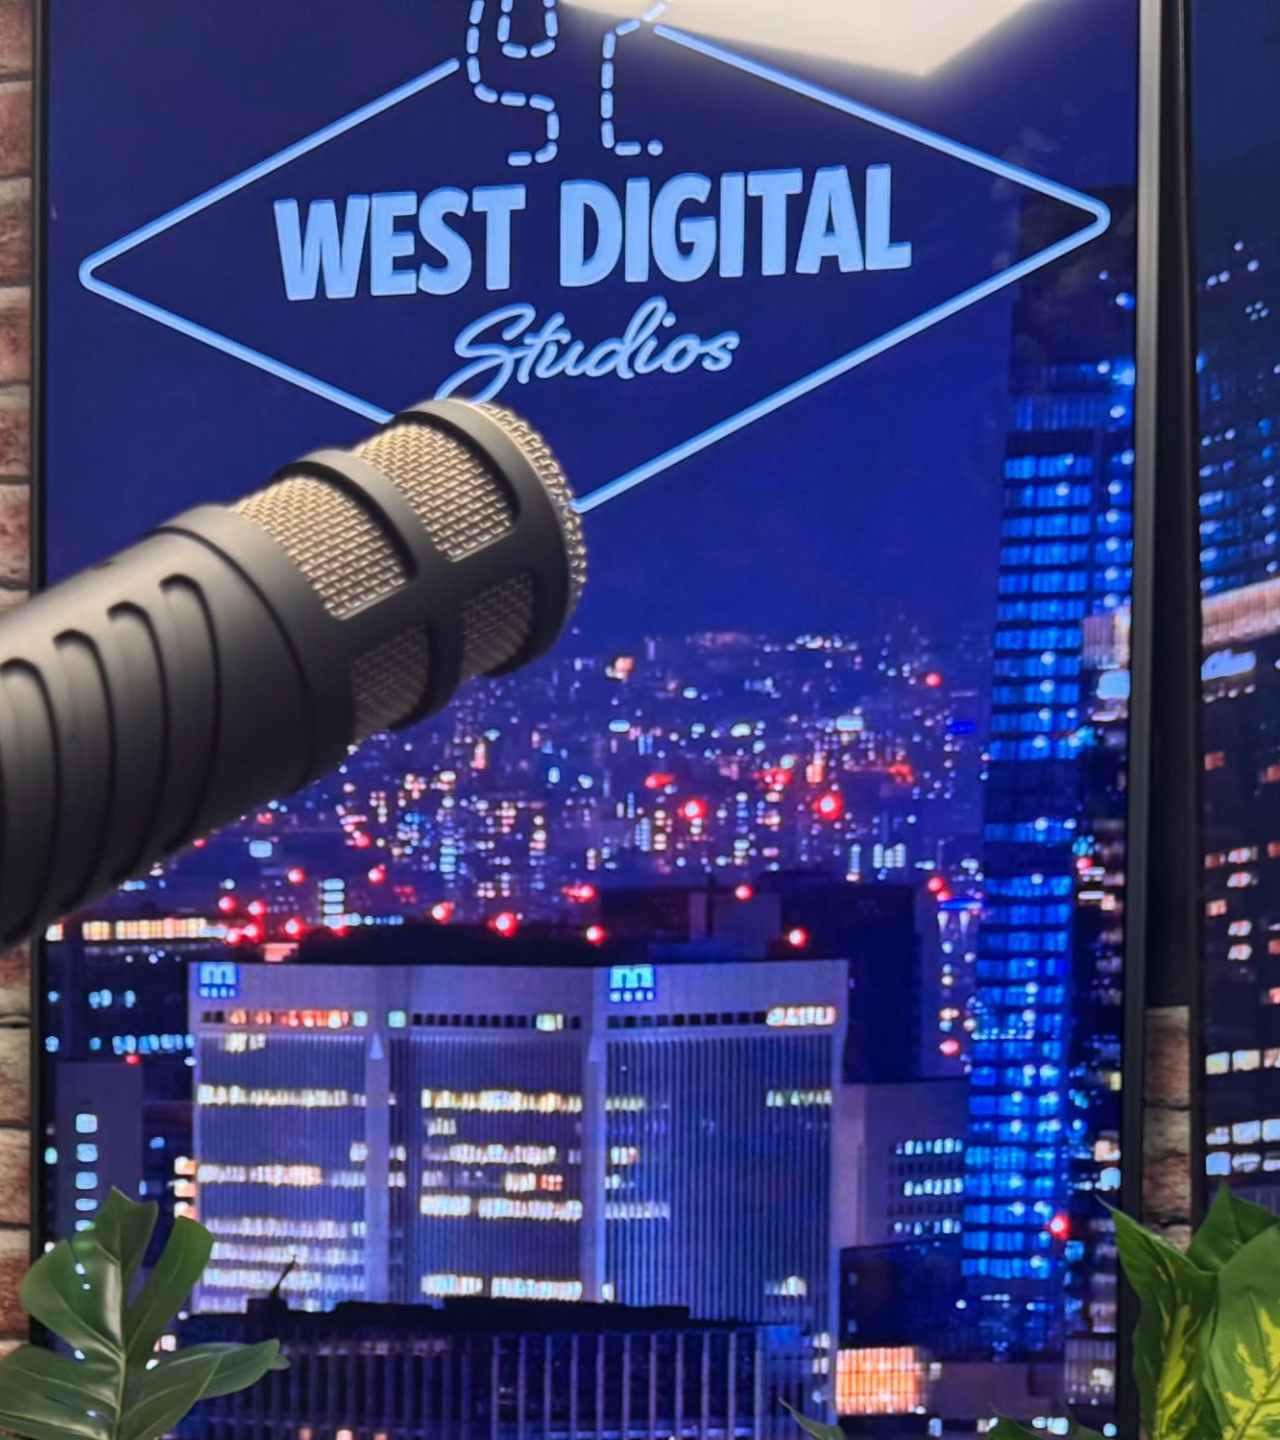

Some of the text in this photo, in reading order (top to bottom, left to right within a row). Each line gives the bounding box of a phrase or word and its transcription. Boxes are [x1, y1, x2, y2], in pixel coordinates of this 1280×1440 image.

[273, 163, 913, 302] WEST DIGITAL
[433, 296, 741, 405] Studios
